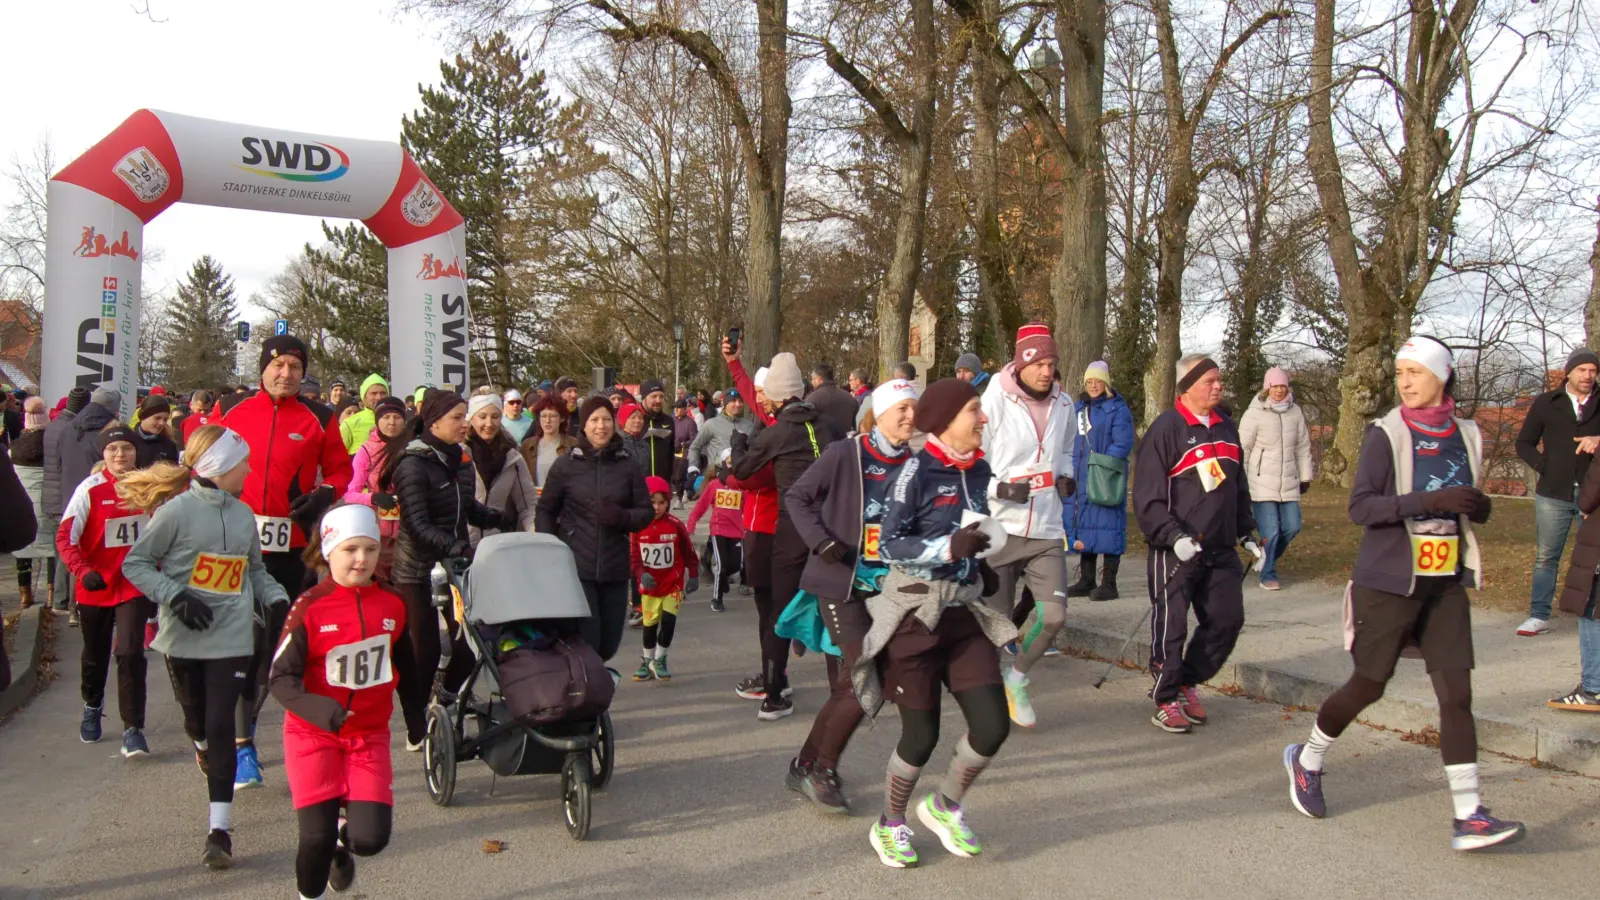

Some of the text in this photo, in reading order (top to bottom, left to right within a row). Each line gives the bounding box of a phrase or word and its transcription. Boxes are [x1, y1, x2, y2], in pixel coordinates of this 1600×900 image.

[242, 137, 331, 172] SWD
[222, 182, 352, 203] STADTWERKE DINKELSBÜHL
[122, 280, 132, 308] hier
[121, 312, 131, 335] für
[424, 292, 436, 328] mehr
[422, 330, 436, 378] Energie
[442, 294, 466, 396] SWD
[119, 341, 132, 394] Energie
[717, 492, 738, 506] 561
[260, 522, 288, 547] 56
[643, 546, 672, 566] 220
[1418, 541, 1450, 570] 89
[193, 556, 242, 589] 578
[382, 618, 396, 631] SB
[336, 644, 385, 686] 167
